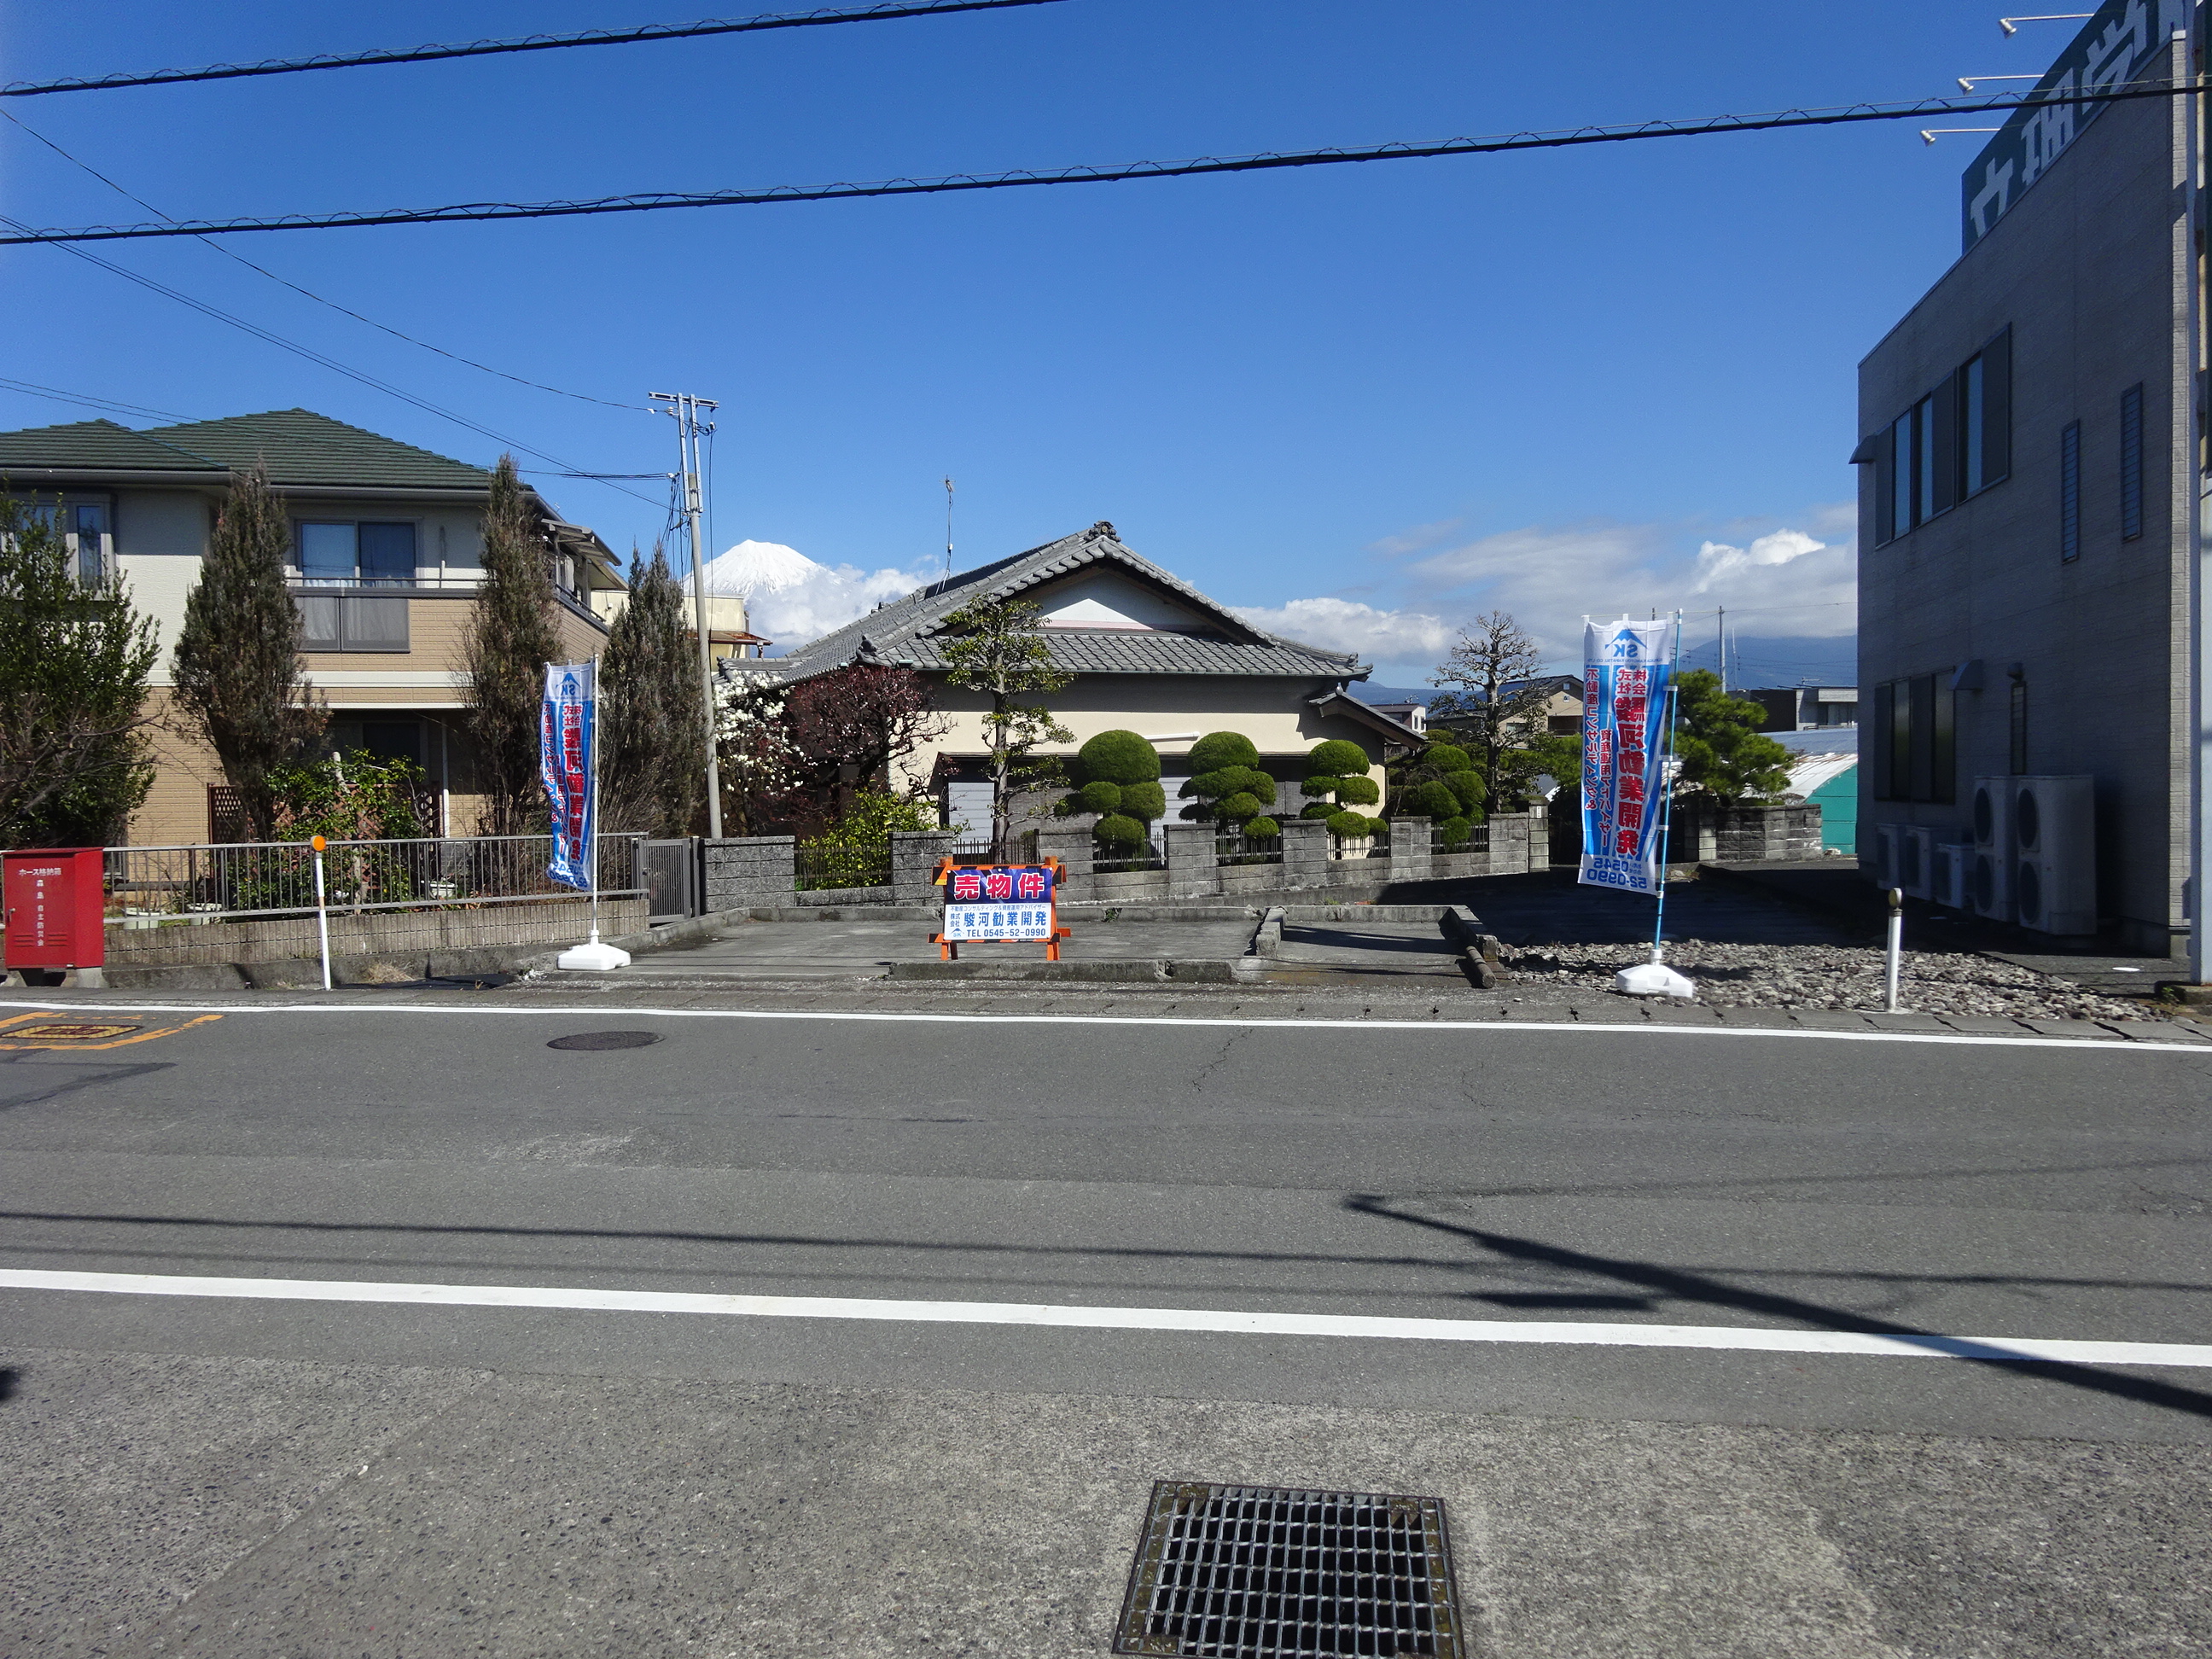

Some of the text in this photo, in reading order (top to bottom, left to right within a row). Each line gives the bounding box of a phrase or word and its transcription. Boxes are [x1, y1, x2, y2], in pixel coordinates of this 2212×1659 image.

[954, 872, 1045, 900] 売物件
[963, 911, 1047, 927] 駿河勧業開発
[983, 928, 1046, 937] 0545-52-0990
